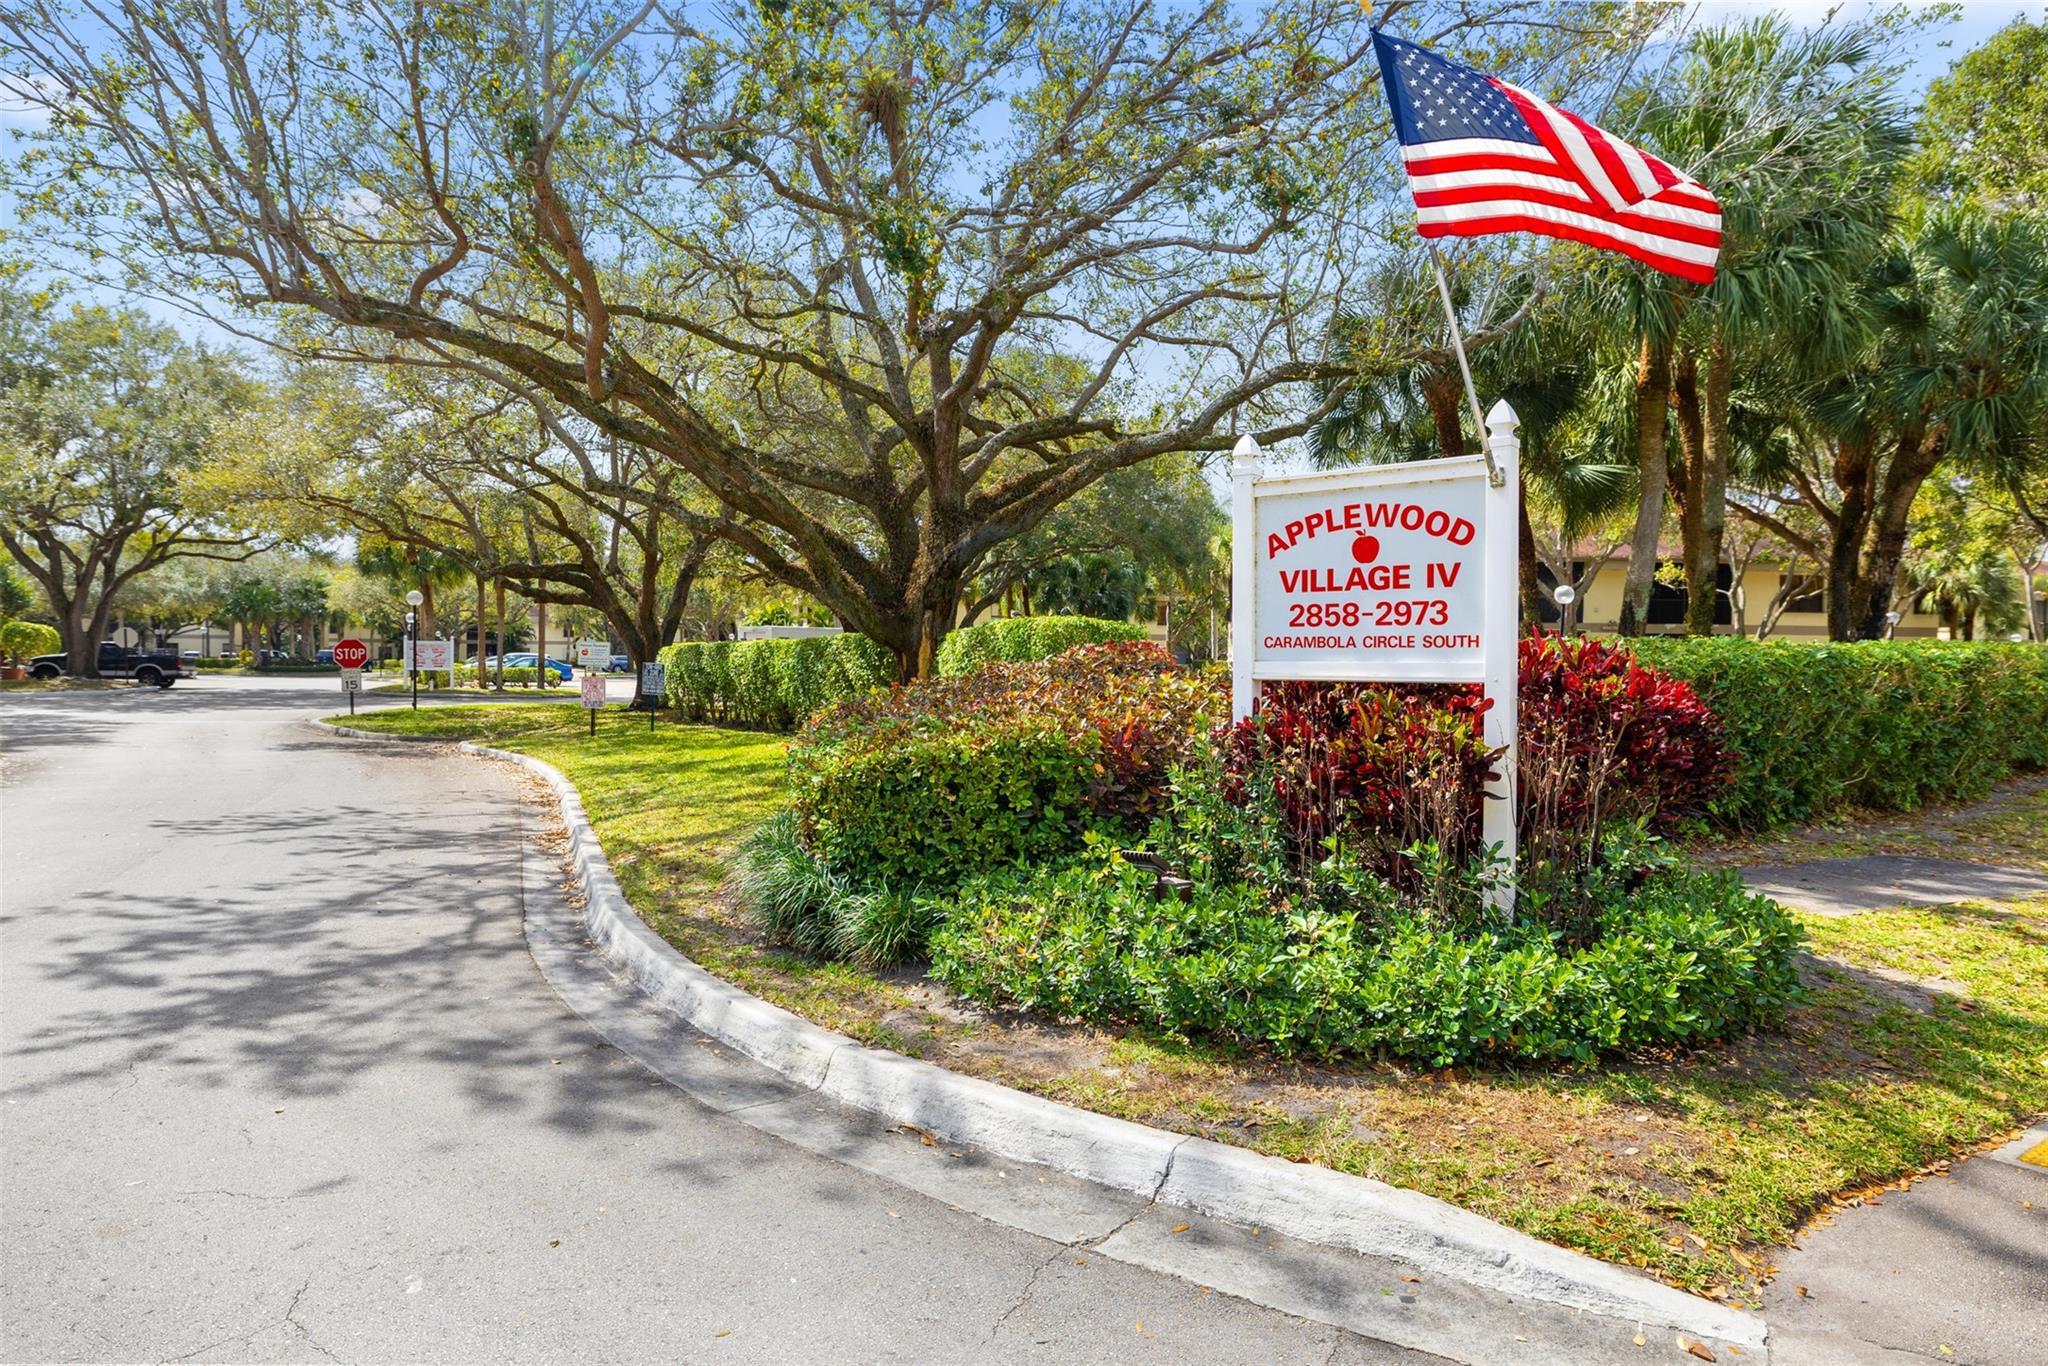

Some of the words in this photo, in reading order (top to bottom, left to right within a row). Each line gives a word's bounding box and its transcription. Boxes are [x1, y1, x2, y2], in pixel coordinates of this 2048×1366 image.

[1267, 503, 1476, 560] APPLEWOOD
[1279, 564, 1411, 593] VILLAGE
[1426, 562, 1462, 588] IV
[1288, 600, 1449, 628] 2858-2973
[1264, 635, 1357, 649] CARAMBOLA
[1363, 635, 1415, 649] CIRCLE
[1422, 634, 1480, 649] SOUTH
[336, 648, 366, 660] STOP
[345, 680, 358, 690] 15
